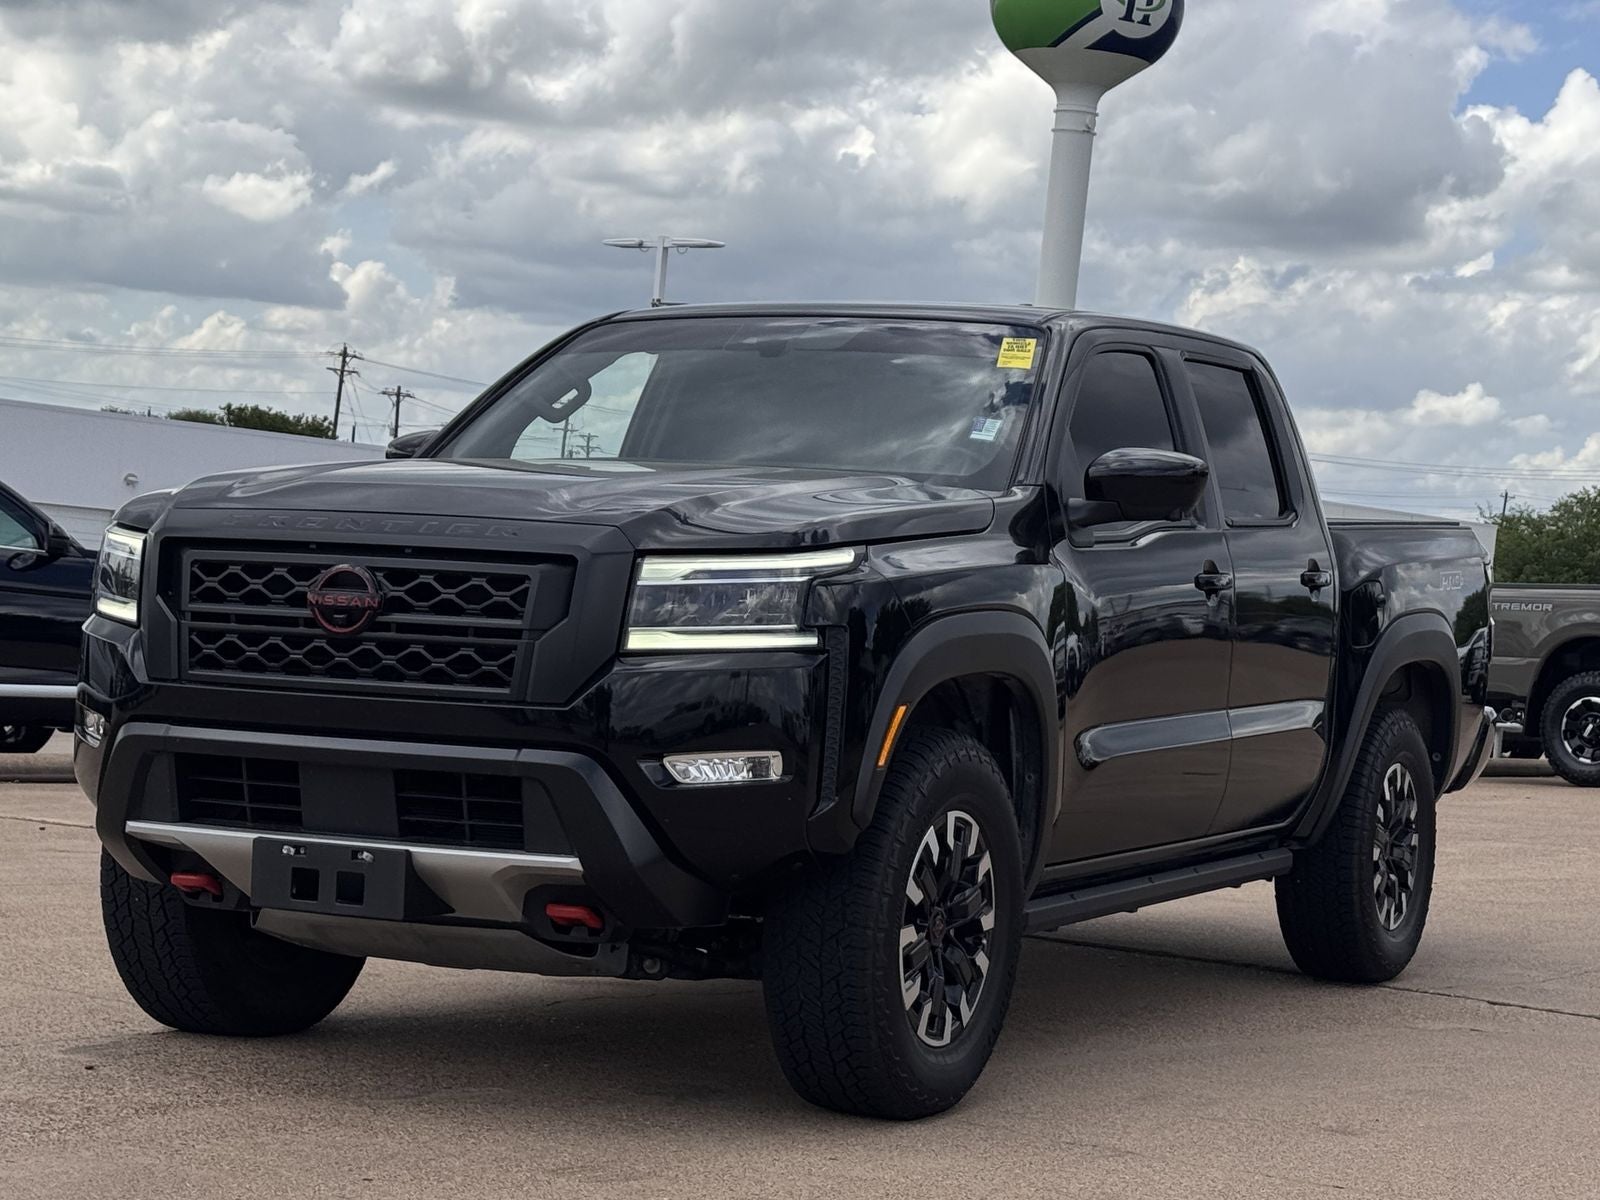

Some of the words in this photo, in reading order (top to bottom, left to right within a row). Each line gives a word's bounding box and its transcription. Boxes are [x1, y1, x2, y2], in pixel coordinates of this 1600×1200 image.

[222, 514, 526, 538] FRONTIER
[307, 592, 379, 608] NISSAN
[1492, 602, 1553, 612] TREMOR
